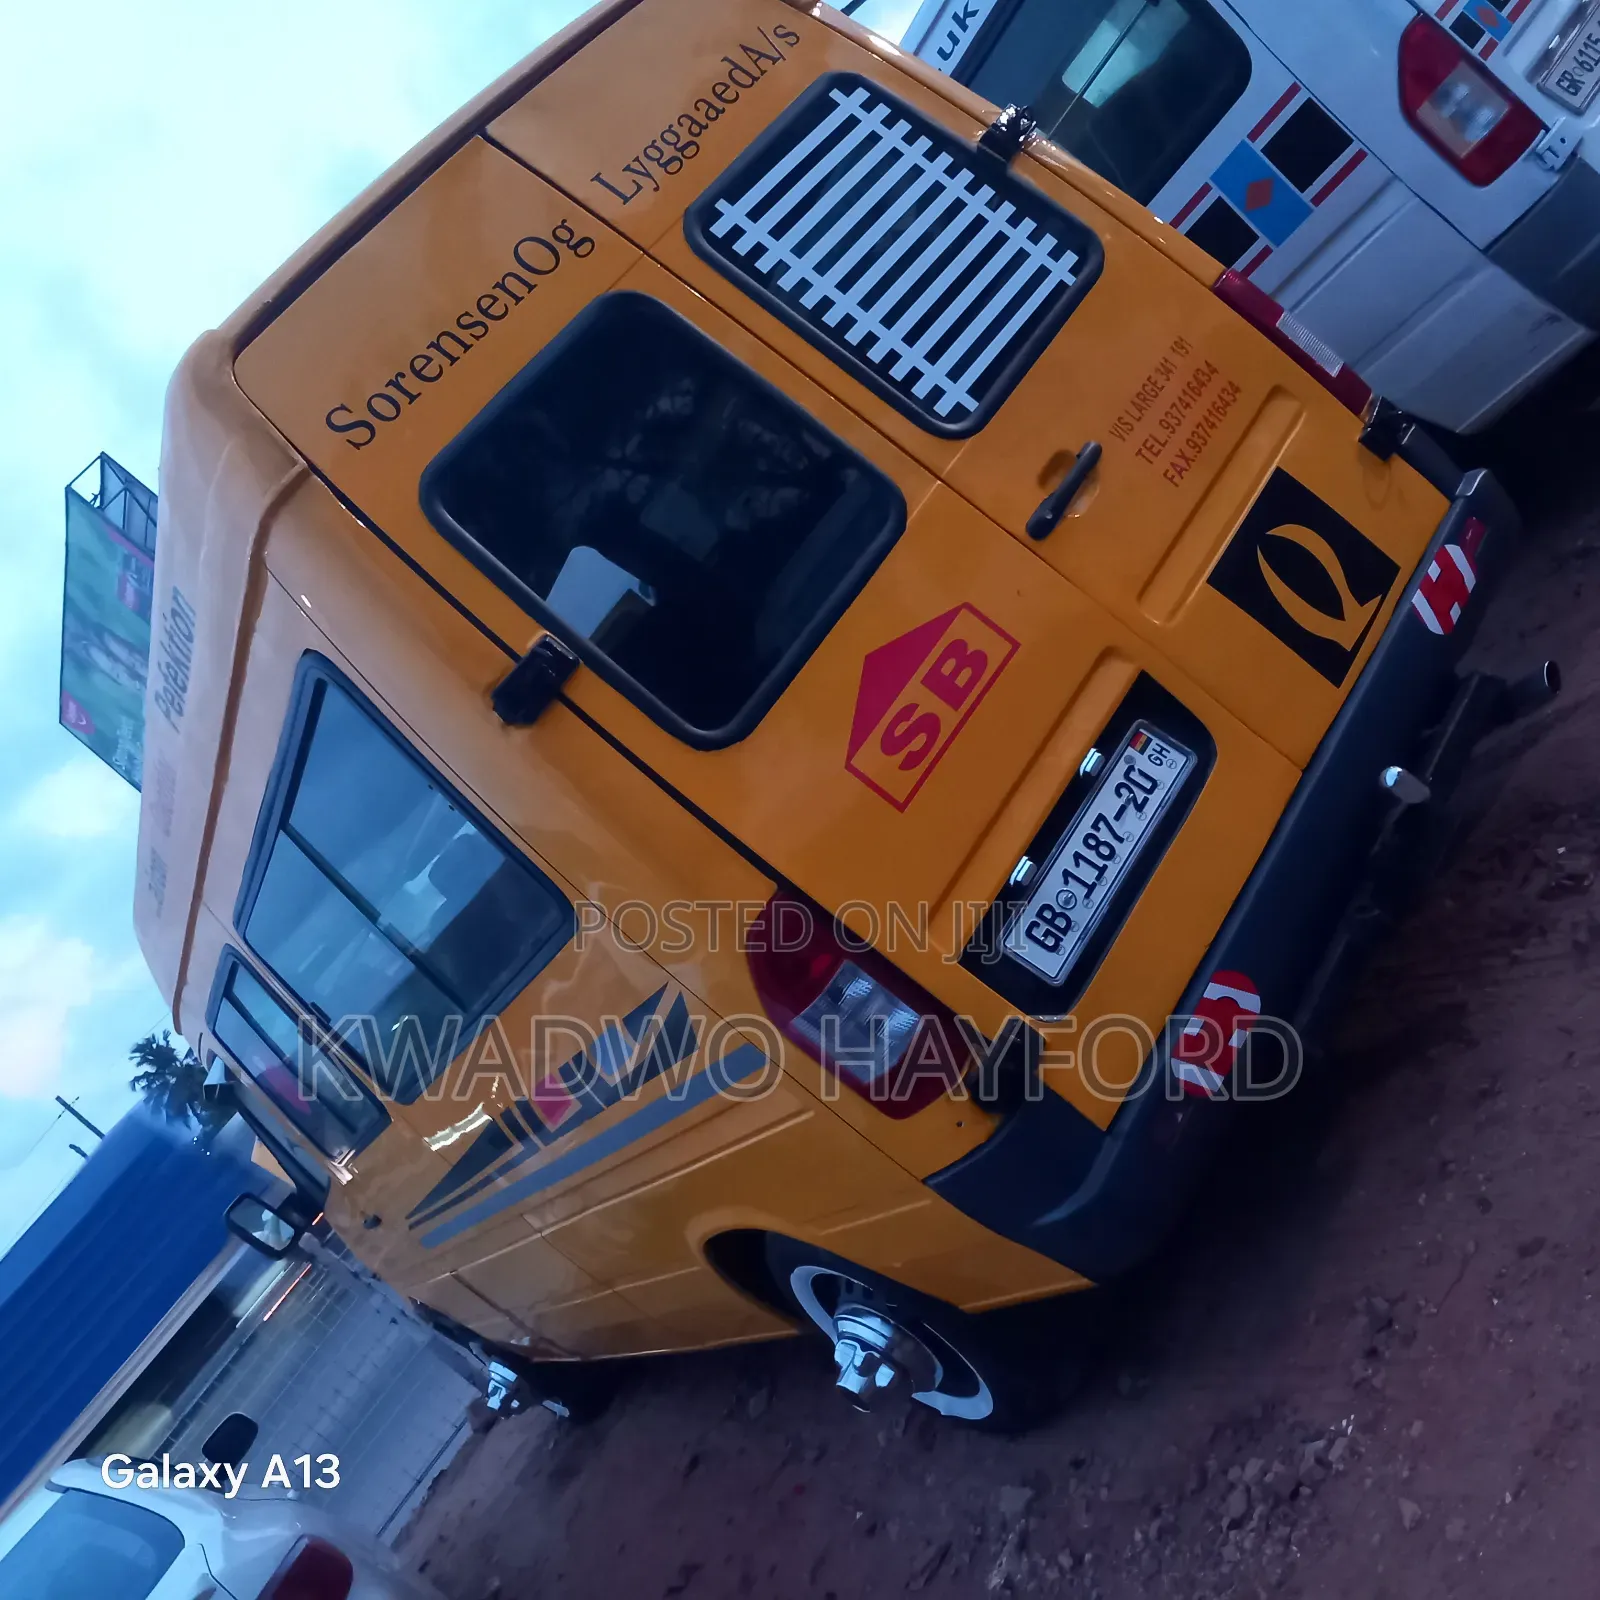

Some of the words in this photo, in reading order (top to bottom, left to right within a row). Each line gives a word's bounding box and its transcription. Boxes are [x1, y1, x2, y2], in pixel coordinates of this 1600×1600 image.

[325, 218, 596, 450] SorensenOg
[590, 22, 801, 206] LyggaaedA/s
[1128, 374, 1166, 422] LARGE
[1157, 356, 1179, 384] 341
[880, 638, 989, 771] SB
[1147, 742, 1171, 767] GH
[1024, 903, 1073, 954] GB
[1061, 764, 1158, 899] 1187-20
